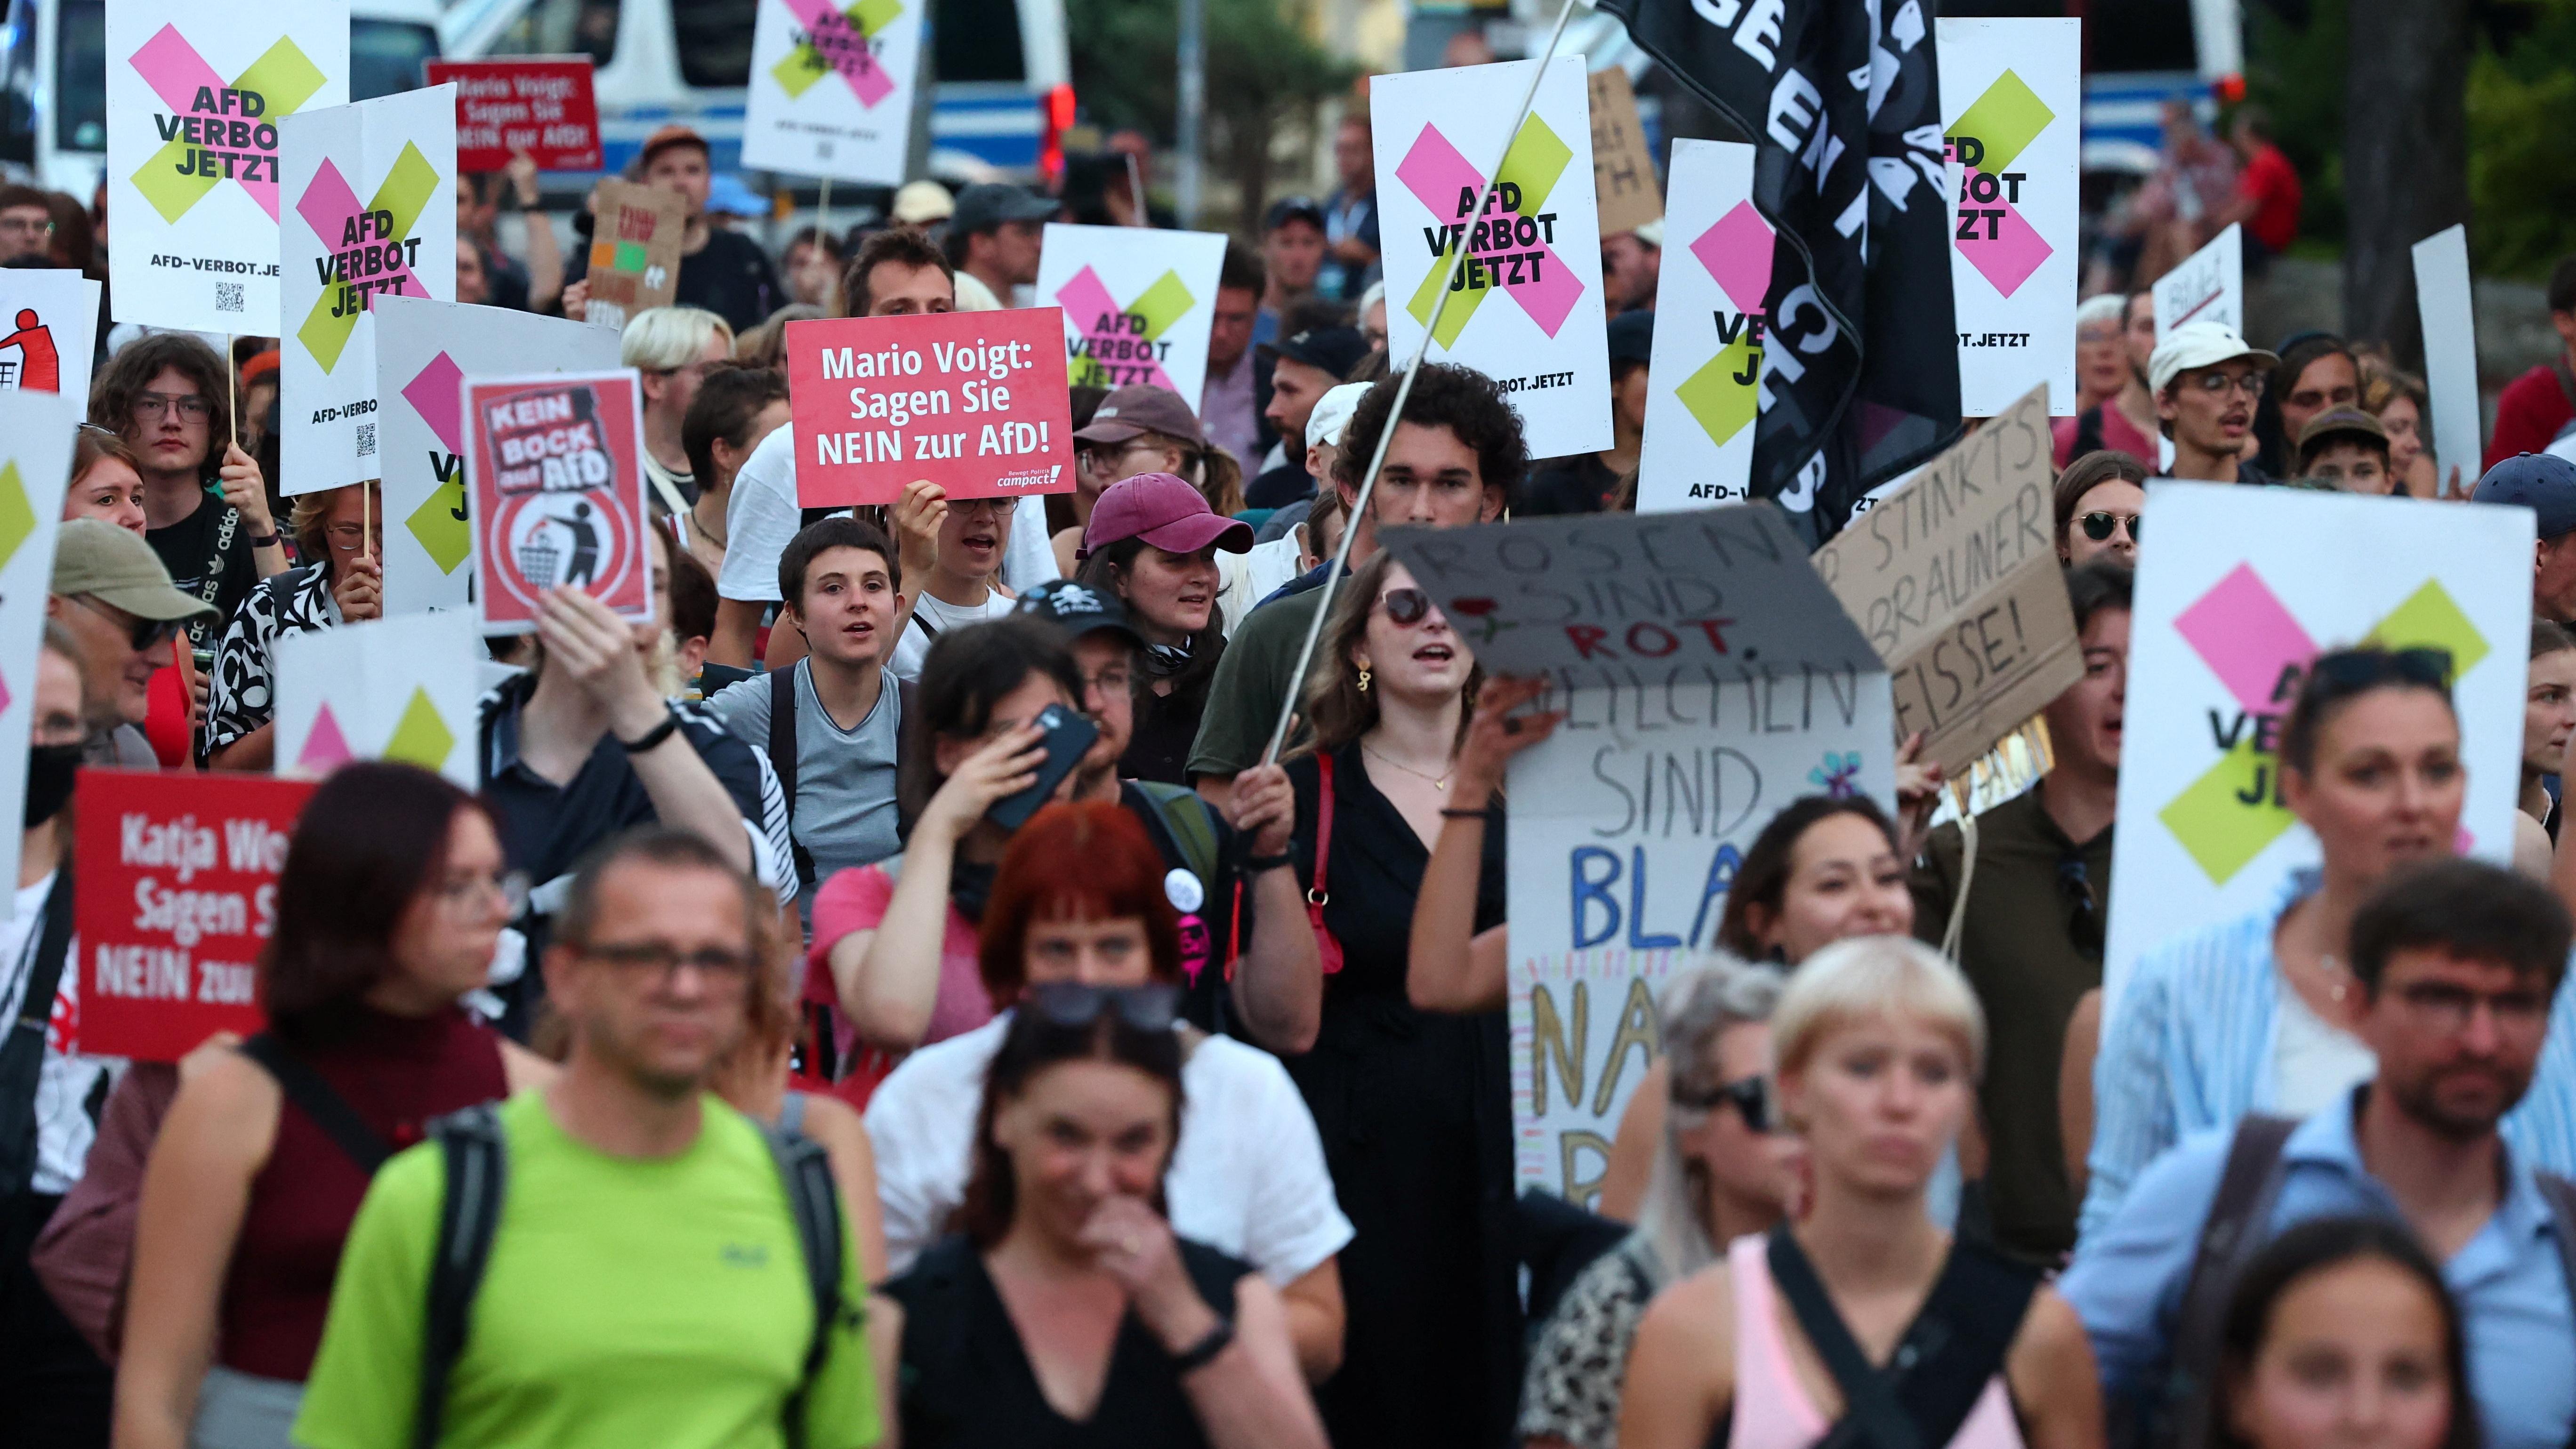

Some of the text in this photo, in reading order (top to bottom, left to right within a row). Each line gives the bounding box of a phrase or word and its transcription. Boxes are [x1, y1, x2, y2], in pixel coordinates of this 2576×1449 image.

[191, 86, 265, 117] AFD
[153, 113, 278, 151] VERBO
[175, 148, 279, 183] JETZT
[1457, 182, 1521, 218] AFD
[341, 209, 394, 247] AFD
[1423, 213, 1557, 257] VERBOT
[151, 254, 280, 277] AFD-VERBOT.JE
[315, 237, 421, 285] VERBOT
[1449, 251, 1545, 292] JETZT
[331, 274, 407, 318] JETZT
[1095, 313, 1147, 334] AFD
[1954, 333, 2030, 347] T.JETZT
[821, 338, 1032, 380] Mario Voigt:
[1067, 337, 1172, 362] VERBOT
[1077, 364, 1155, 387] JETZT
[1491, 371, 1574, 393] BOT.JETZT
[312, 399, 378, 424] AFD-VERBO
[490, 393, 572, 433] KEIN
[850, 379, 1011, 427] Sagen Sie
[501, 423, 596, 466] BOCK
[817, 421, 1049, 466] NEIN zur AfD!
[499, 467, 540, 489] auf
[542, 448, 609, 490] AfD
[1870, 398, 2037, 572] STINKTS
[217, 507, 239, 550] adida
[1412, 518, 1783, 580] ROSEN
[1867, 482, 2048, 658] BRAUNER
[1520, 573, 1723, 622] SIND
[1565, 618, 1758, 660] ROT.
[1892, 596, 2029, 748] EISSE!
[1591, 745, 1762, 838] SIND
[121, 813, 218, 883] Katja
[134, 876, 247, 948] Sagen
[1570, 843, 1747, 950] BLA
[95, 942, 191, 1001] NEIN
[1531, 976, 1661, 1117] NA
